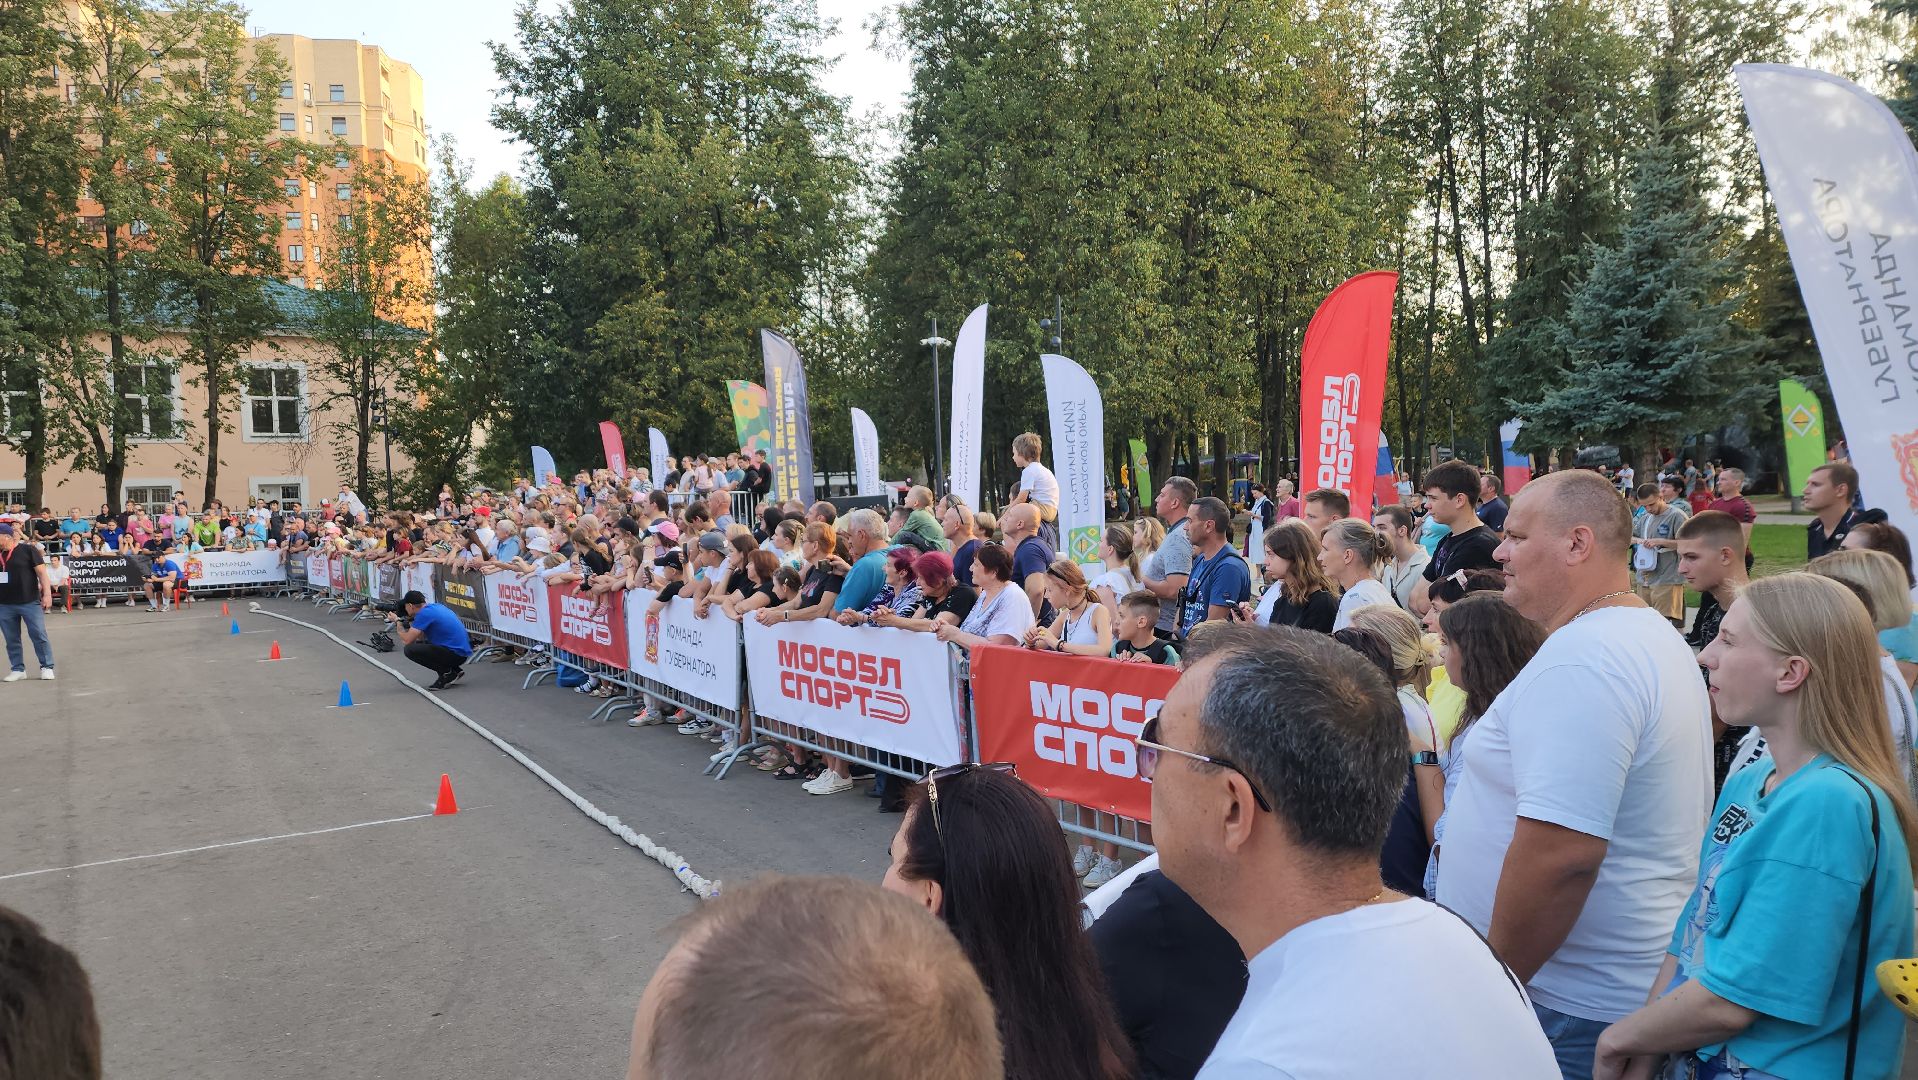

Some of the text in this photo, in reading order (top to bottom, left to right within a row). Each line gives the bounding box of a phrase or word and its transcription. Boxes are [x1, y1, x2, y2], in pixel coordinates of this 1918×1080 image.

[1316, 375, 1343, 490] ОСОБЛ
[68, 558, 127, 568] ГОРОДСКОЙ
[69, 568, 100, 576] ОКРУГ
[210, 569, 268, 577] ГУБЕРНАТОРА
[499, 601, 527, 619] СПОРТ
[561, 615, 599, 643] СПОРТ
[666, 624, 703, 648] КОМАНДА
[665, 649, 717, 680] ГУБЕРНАТОРА
[778, 640, 902, 690] МОСОБЛ
[780, 671, 873, 717] СПОРТ
[1033, 722, 1153, 783] СПО
